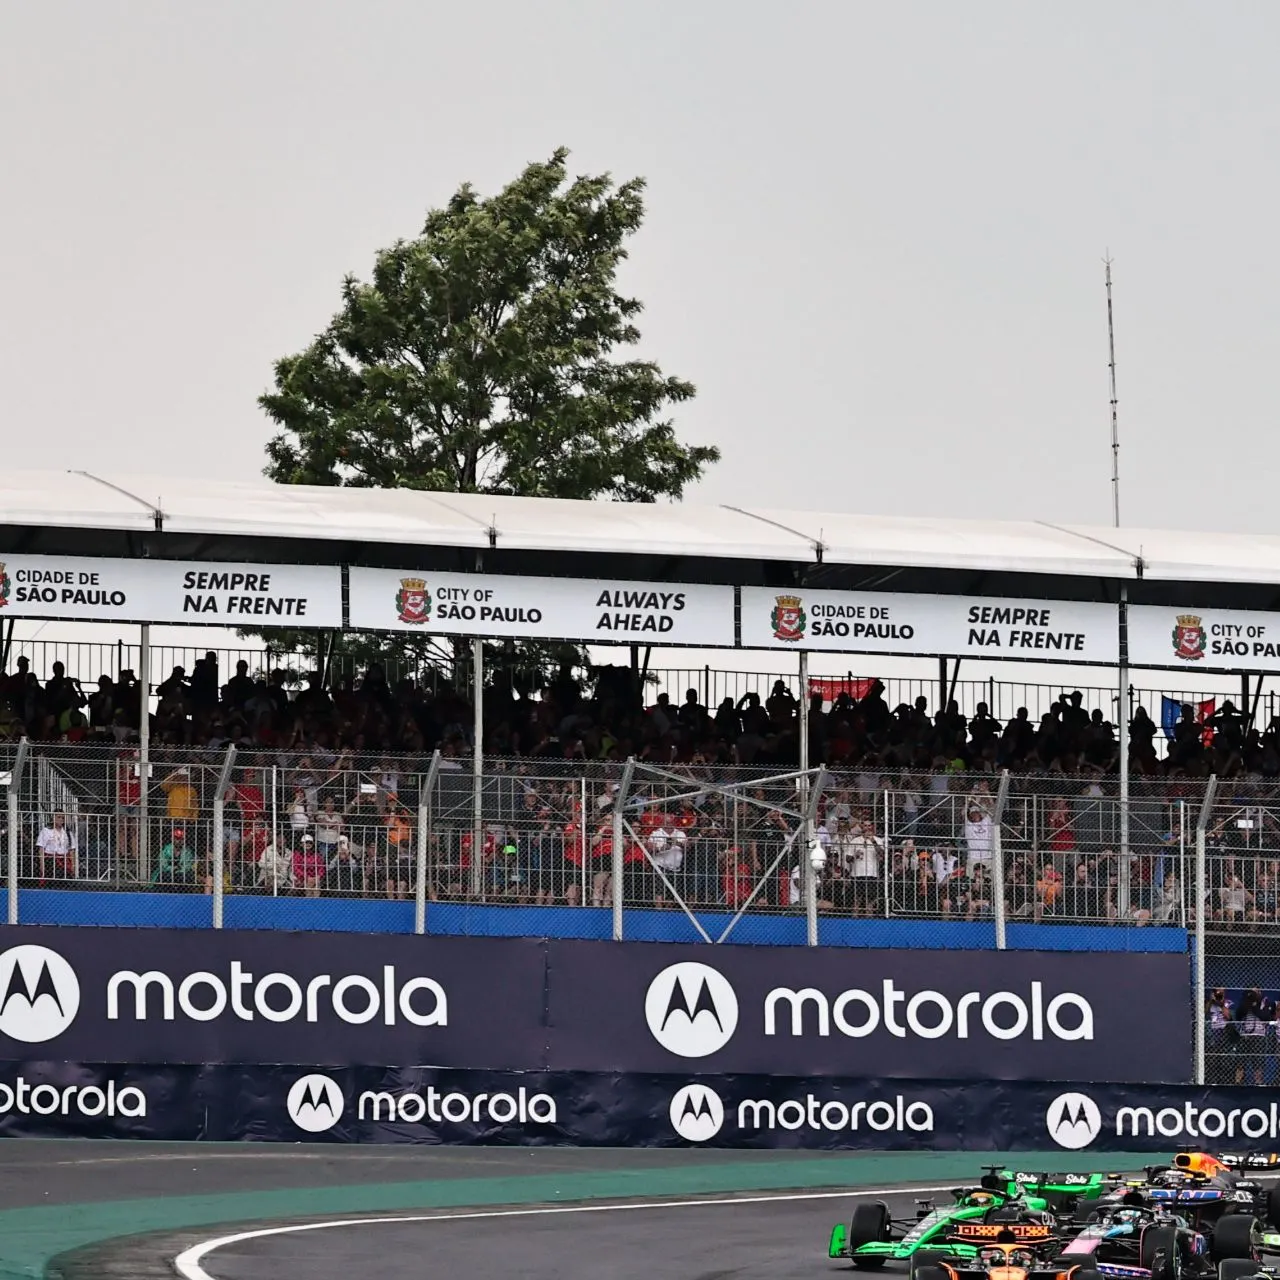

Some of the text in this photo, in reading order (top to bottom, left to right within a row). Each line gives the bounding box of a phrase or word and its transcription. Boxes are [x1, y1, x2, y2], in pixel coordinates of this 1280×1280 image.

[16, 570, 99, 585] CIDADE DE
[183, 572, 270, 591] SEMPRE
[16, 584, 125, 605] SÃO PAULO
[437, 588, 493, 601] CITY OF
[596, 590, 685, 610] ALWAYS
[184, 595, 307, 615] NA FRENTE
[438, 602, 541, 623] SÃO PAULO
[811, 605, 888, 619] CIDADE DE
[597, 613, 673, 632] AHEAD
[968, 606, 1050, 626] SEMPRE
[812, 619, 913, 639] SÃO PAULO
[1212, 624, 1265, 638] CITY OF
[968, 629, 1085, 650] NA FRENTE
[1212, 638, 1249, 655] SÃO
[108, 961, 447, 1025] motorola
[765, 980, 1093, 1040] motorola
[0, 1077, 146, 1117] torola
[359, 1087, 556, 1123] motorola
[738, 1094, 933, 1131] motorola
